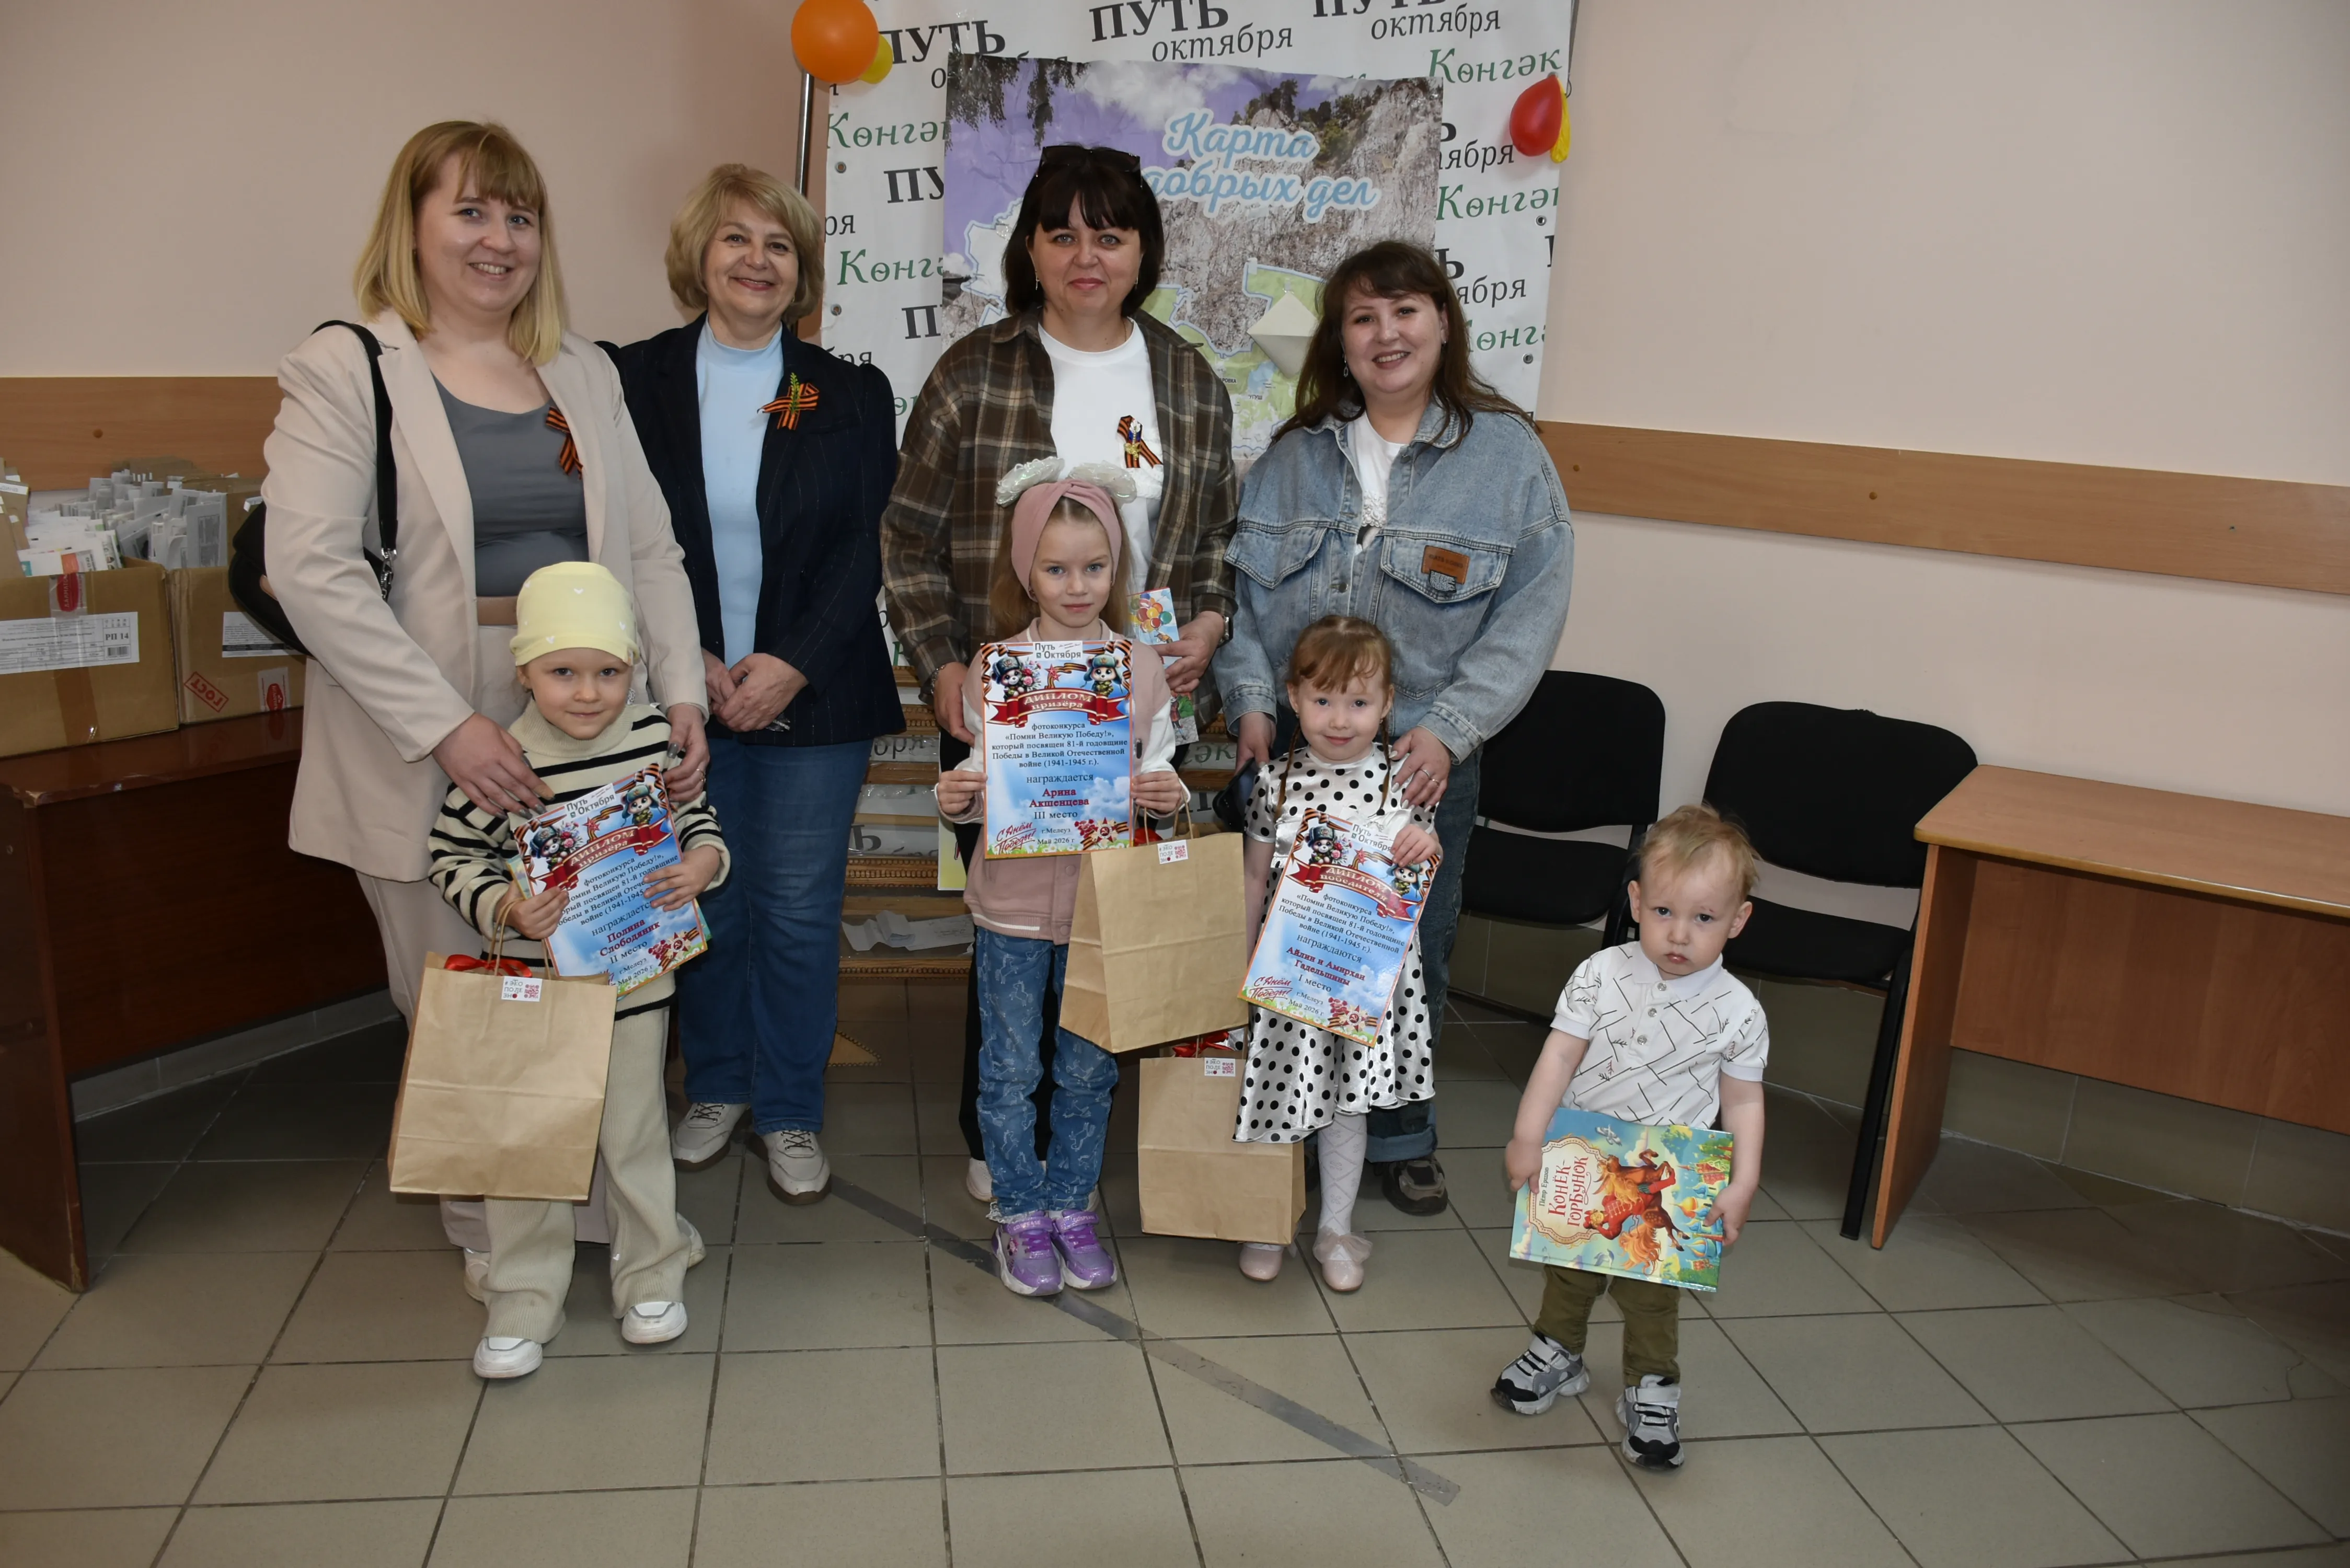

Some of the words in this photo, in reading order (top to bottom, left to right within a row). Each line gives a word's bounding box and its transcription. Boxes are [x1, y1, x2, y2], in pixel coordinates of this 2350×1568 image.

[1089, 0, 1228, 42] ПУТЬ
[1371, 3, 1501, 39] октября
[1152, 22, 1293, 62] октября
[1167, 112, 1316, 168] Карта
[1307, 180, 1377, 218] дел
[1035, 643, 1055, 652] Путь
[1044, 650, 1081, 659] Октября
[191, 678, 223, 706] ГОСТ
[1023, 693, 1093, 705] ДИПЛОМ
[1031, 700, 1084, 710] призёра
[1032, 723, 1085, 731] фотоконкурса
[1076, 730, 1114, 739] Победу!»,
[1044, 759, 1086, 768] (1941-1945
[1067, 748, 1125, 757] Отечественной
[1026, 774, 1094, 785] награждается
[566, 799, 588, 811] Путь
[577, 794, 614, 815] Октября
[1029, 799, 1089, 808] Акшенцева
[1042, 788, 1077, 798] Арина
[1005, 822, 1033, 837] Днём
[1352, 824, 1371, 837] Путь
[568, 827, 634, 866] ДИПЛОМ
[578, 840, 627, 867] призёра
[995, 831, 1036, 855] Победы!
[583, 884, 620, 905] посвящен
[621, 874, 638, 886] 81-й
[639, 855, 677, 877] годовщине
[584, 858, 635, 886] фотоконкурса
[592, 872, 626, 891] Великую
[627, 855, 664, 874] Победу!»,
[1326, 864, 1388, 892] ДИПЛОМ
[1320, 872, 1387, 901] победителя
[558, 912, 582, 926] обеды
[590, 892, 622, 911] Великой
[580, 912, 603, 925] войне
[604, 889, 644, 915] (1941-1945
[1296, 894, 1324, 907] «Помни
[1326, 903, 1358, 919] Великую
[1360, 915, 1394, 933] Победу!»,
[1323, 893, 1372, 915] фотоконкурса
[592, 902, 652, 936] награждаетс
[1278, 905, 1306, 920] Победы
[1314, 917, 1344, 933] Великой
[1345, 929, 1399, 953] Отечественной
[1281, 898, 1311, 912] который
[1312, 909, 1347, 925] посвящен
[1348, 920, 1365, 931] 81-й
[1366, 928, 1404, 946] годовщине
[600, 921, 660, 956] Слободяник
[606, 920, 645, 943] Полина
[1299, 923, 1320, 934] войне
[1321, 930, 1361, 948] (1941-1945
[620, 941, 647, 959] место
[1297, 935, 1362, 963] награждаются
[617, 975, 632, 986] Май
[633, 966, 648, 978] 2026
[619, 958, 647, 974] г.Мелеуз
[1286, 947, 1316, 962] Айлин
[1325, 961, 1365, 981] Амирхан
[1295, 959, 1350, 986] Гадельшины
[1249, 978, 1291, 1008] Победы!
[1264, 976, 1292, 993] Днём
[1305, 978, 1331, 992] место
[1288, 999, 1303, 1008] Май
[1304, 1005, 1319, 1014] 2026
[1296, 991, 1323, 1005] г.Мелеуз
[1539, 1190, 1548, 1206] Пётр
